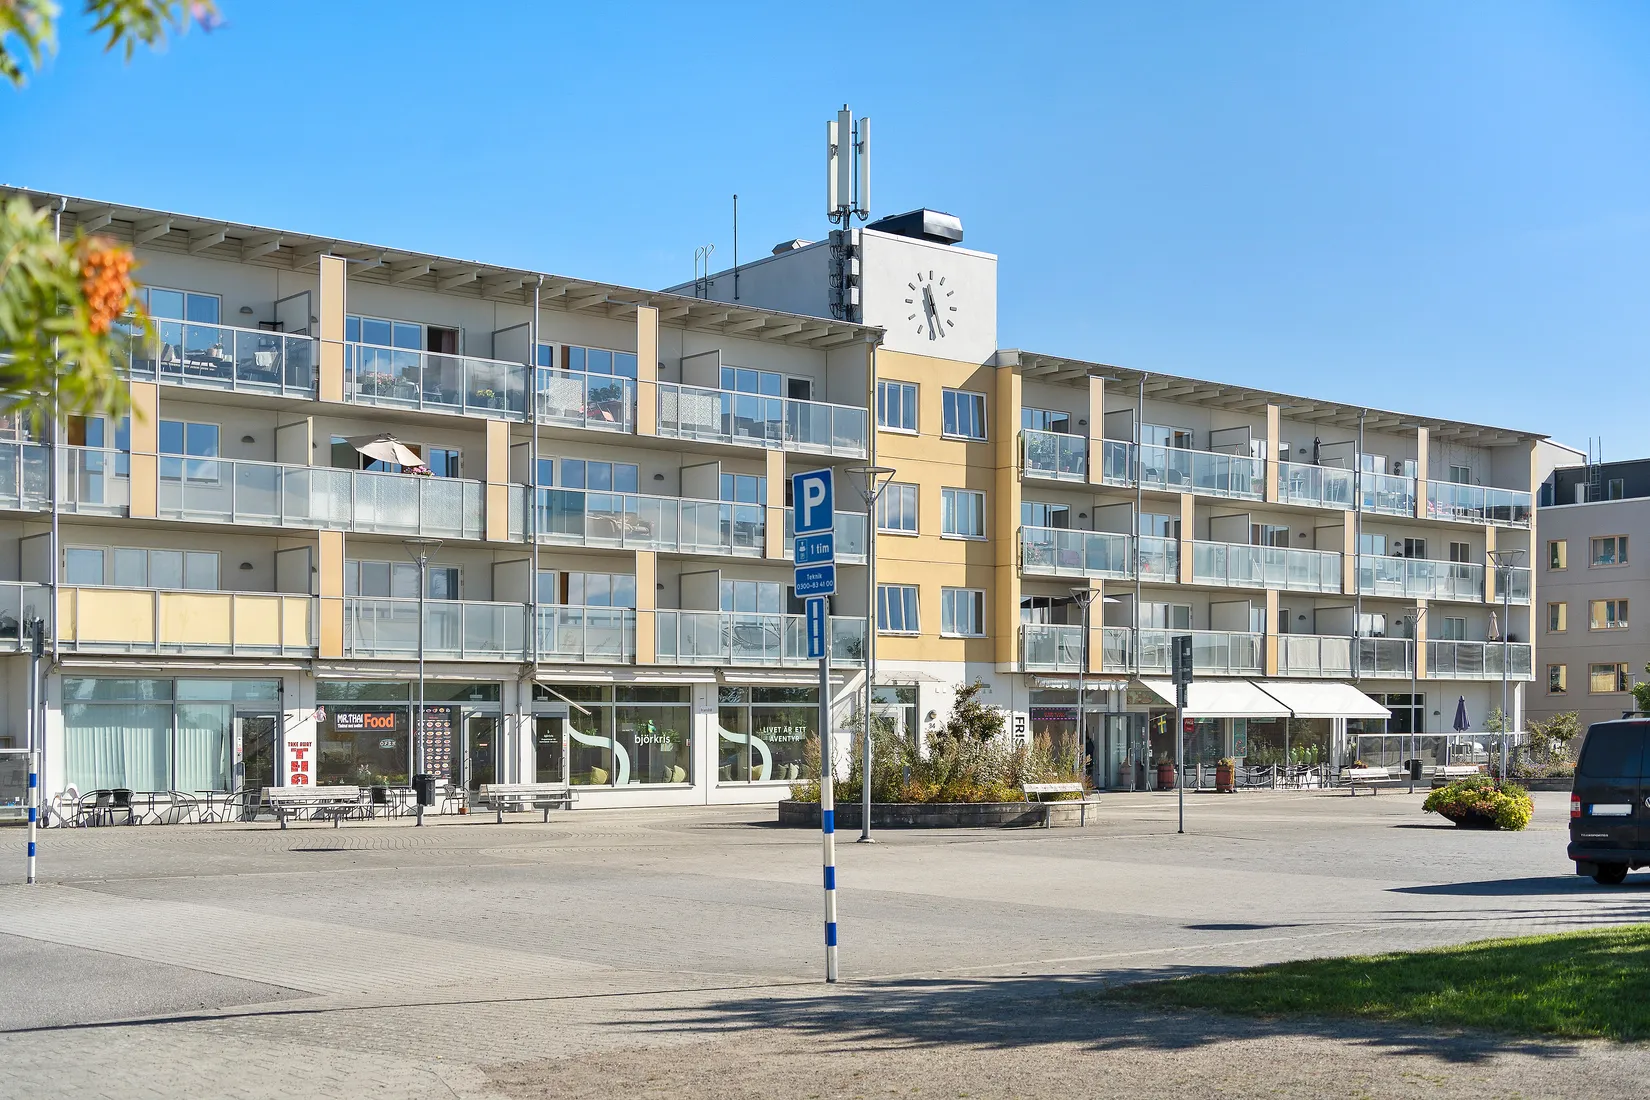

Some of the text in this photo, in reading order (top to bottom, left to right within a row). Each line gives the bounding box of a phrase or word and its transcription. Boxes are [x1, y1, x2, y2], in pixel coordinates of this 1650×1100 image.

[803, 477, 826, 527] P
[811, 543, 830, 555] 1 tim
[364, 713, 394, 728] Food
[783, 725, 793, 733] ÄR
[634, 734, 671, 747] björkris
[291, 748, 309, 787] THA
